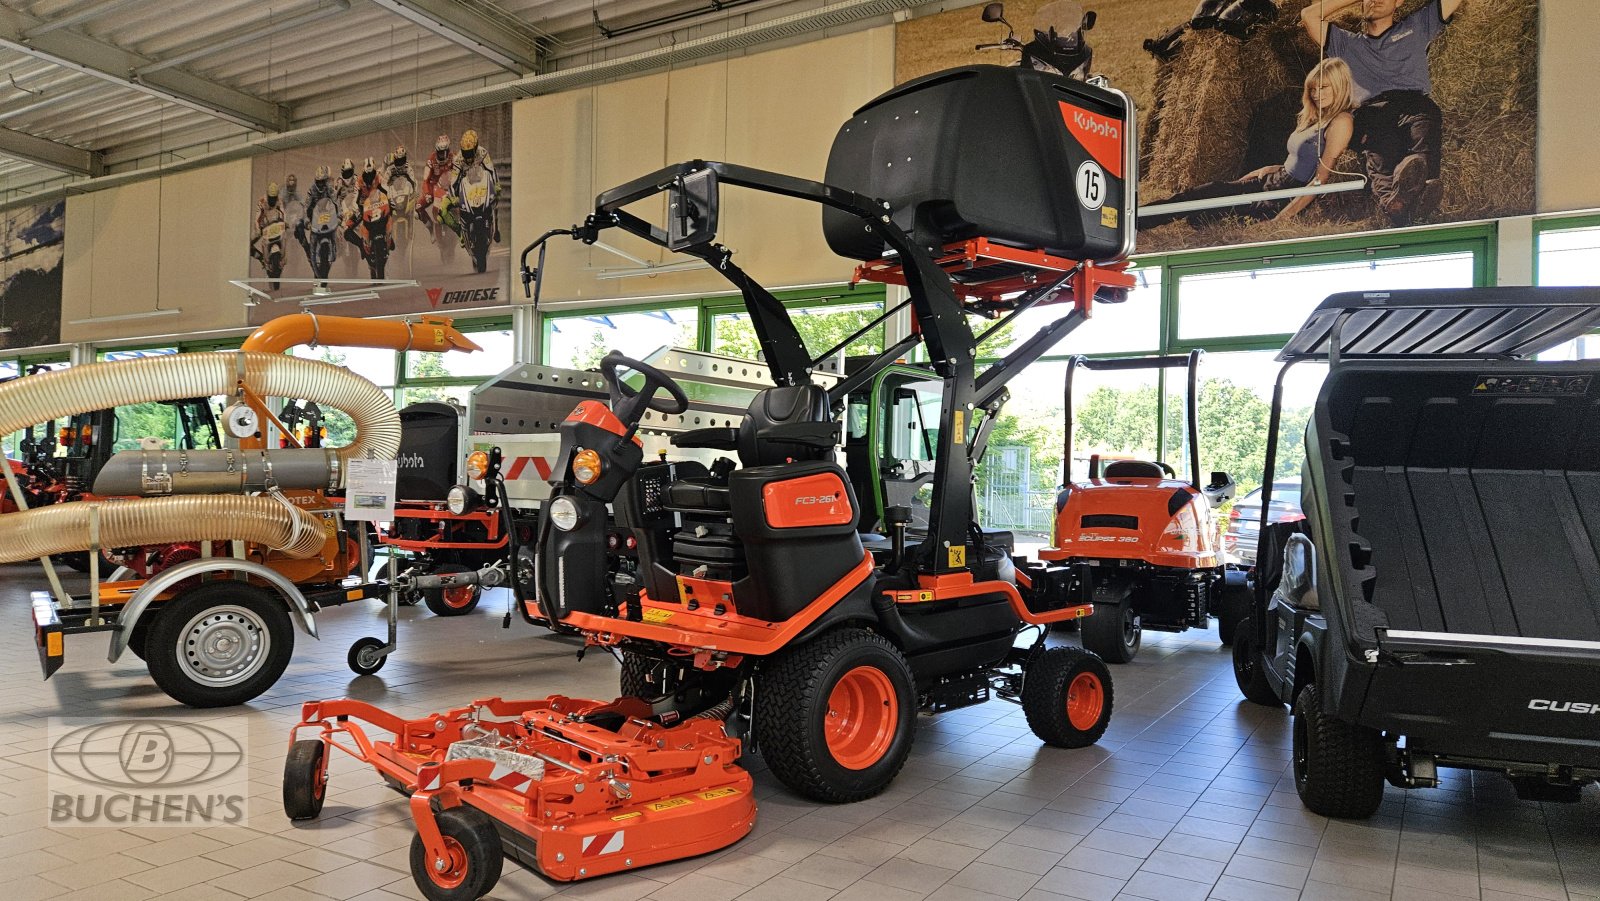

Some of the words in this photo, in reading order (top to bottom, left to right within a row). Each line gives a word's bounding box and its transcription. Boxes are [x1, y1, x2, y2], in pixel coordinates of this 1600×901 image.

[1073, 111, 1118, 139] Kubota
[1084, 169, 1100, 202] 15
[397, 452, 425, 468] ubota
